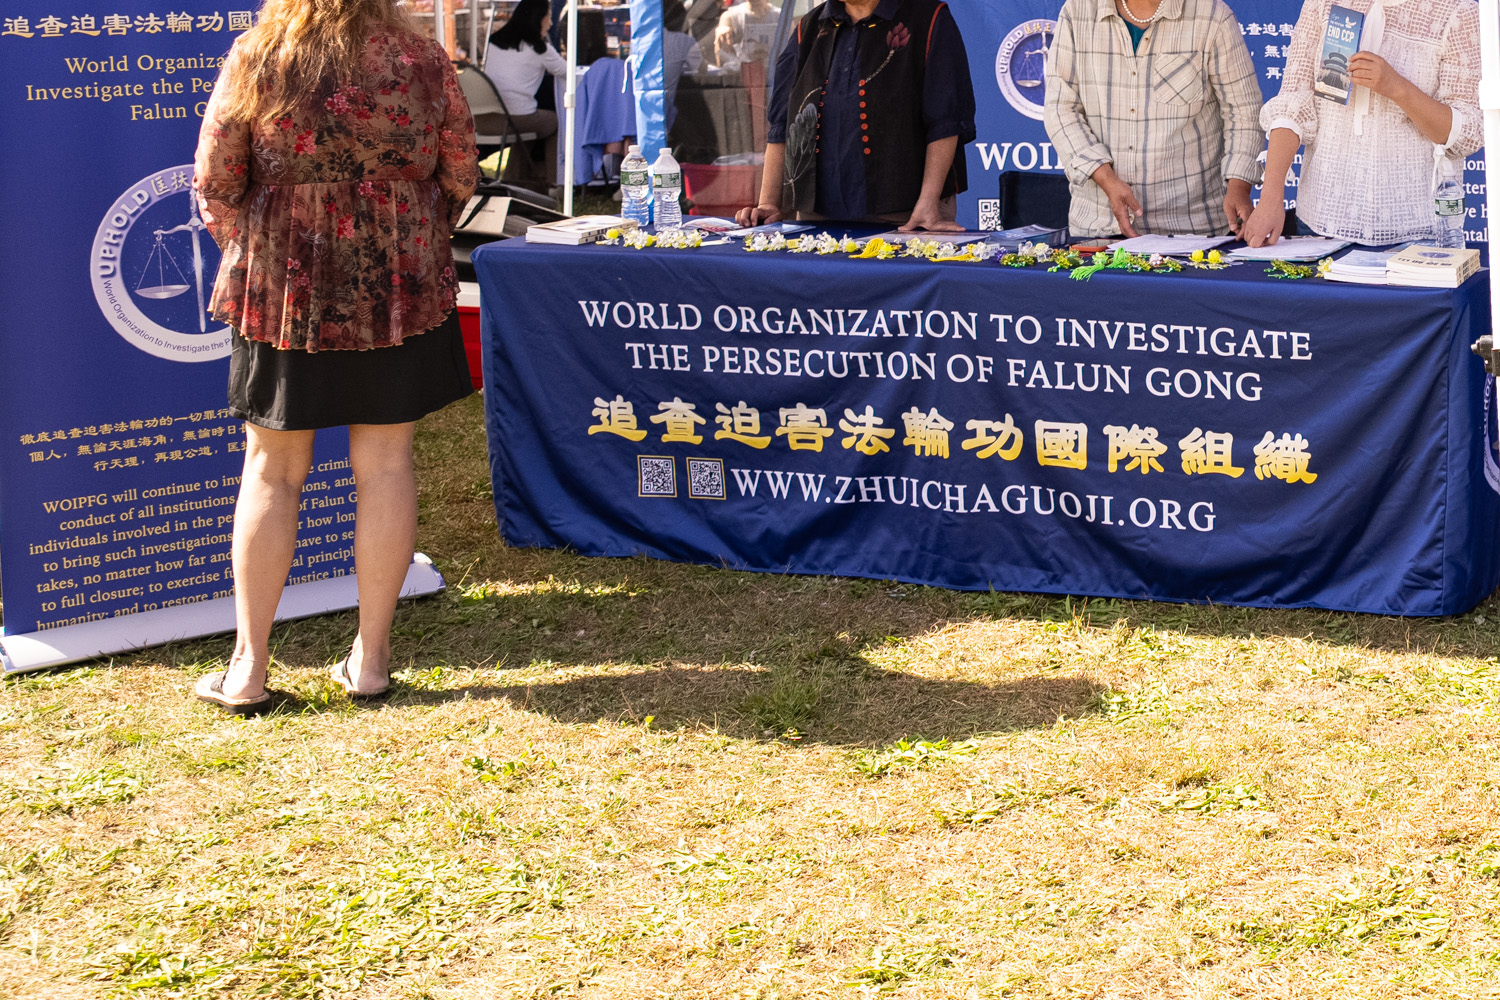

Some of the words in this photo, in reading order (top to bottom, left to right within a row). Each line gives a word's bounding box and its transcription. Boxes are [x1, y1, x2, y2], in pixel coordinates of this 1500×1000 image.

[2, 10, 254, 38] 追查迫害法輪功國
[1327, 25, 1341, 39] END
[1341, 29, 1355, 43] CCP
[26, 82, 144, 102] Investigate
[152, 78, 184, 95] the
[65, 55, 129, 73] World
[137, 53, 225, 74] Organiza
[130, 103, 187, 121] Falun
[975, 142, 1064, 171] WOI
[99, 189, 150, 278] UPHOLD
[103, 279, 116, 305] World
[113, 304, 154, 343] Organization
[154, 337, 164, 347] to
[164, 341, 210, 353] Investigate
[211, 338, 225, 349] the
[578, 301, 702, 330] WORLD
[713, 304, 978, 341] ORGANIZATION
[990, 314, 1042, 344] TO
[1056, 317, 1313, 362] INVESTIGATE
[625, 343, 691, 372] THE
[702, 345, 937, 382] PERSECUTION
[946, 354, 994, 384] OF
[1007, 359, 1131, 394] FALUN
[1146, 368, 1263, 401] GONG
[587, 394, 1318, 484] 追查迫害法輪功國際組織
[29, 532, 108, 555] individuals
[113, 522, 170, 542] involved
[174, 520, 188, 532] in
[192, 516, 213, 529] the
[311, 495, 345, 508] Falun
[43, 494, 108, 514] WOIPFG
[112, 489, 138, 502] will
[142, 482, 201, 499] continue
[204, 479, 219, 489] to
[59, 513, 115, 531] conduct
[120, 509, 134, 521] of
[138, 505, 155, 518] all
[334, 474, 355, 487] and
[729, 467, 1217, 533] WWW.ZHUICHAGUOJI.ORG
[37, 577, 78, 594] takes,
[83, 574, 101, 585] no
[106, 565, 151, 582] matter
[155, 560, 184, 573] how
[188, 553, 205, 567] far
[210, 549, 232, 563] and
[326, 534, 339, 543] to
[43, 562, 58, 573] to
[63, 555, 101, 571] bring
[105, 547, 136, 563] such
[141, 531, 233, 556] investigations
[307, 515, 333, 528] how
[42, 601, 56, 612] to
[61, 594, 85, 609] full
[89, 585, 145, 604] closure;
[149, 582, 163, 594] to
[167, 572, 219, 590] exercise
[308, 548, 355, 569] principl
[114, 603, 140, 619] and
[143, 601, 158, 612] to
[162, 590, 209, 608] restore
[288, 571, 329, 586] justice
[333, 567, 345, 578] in
